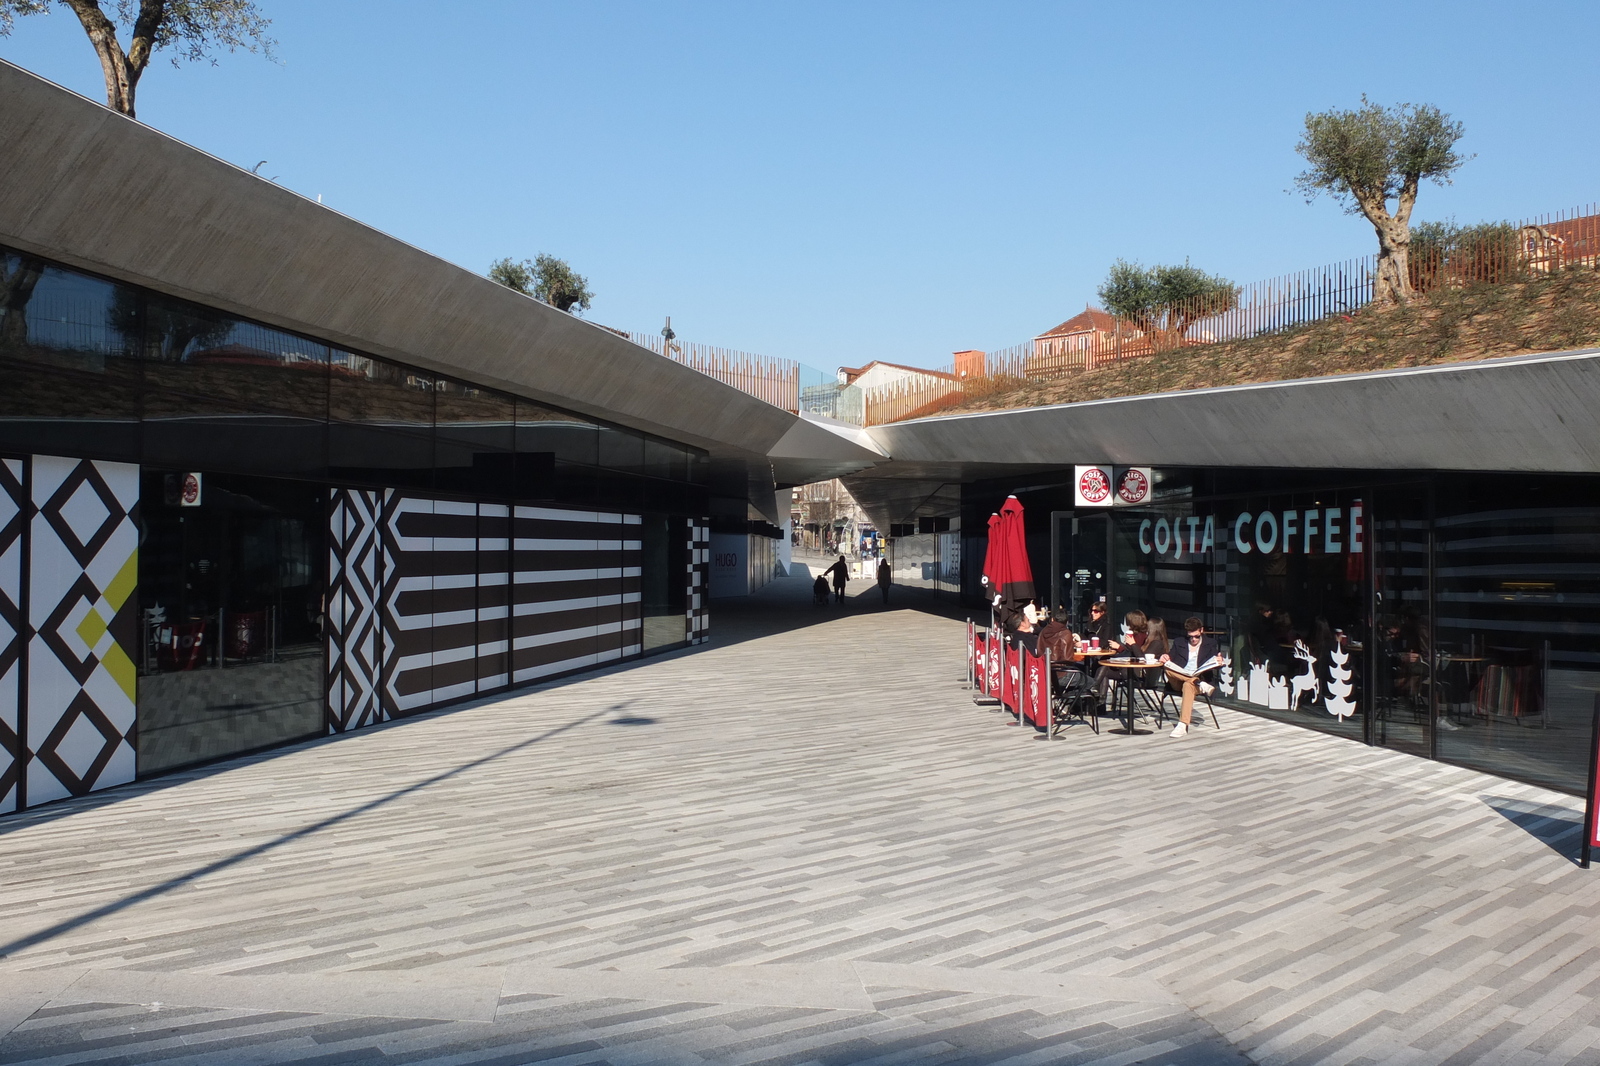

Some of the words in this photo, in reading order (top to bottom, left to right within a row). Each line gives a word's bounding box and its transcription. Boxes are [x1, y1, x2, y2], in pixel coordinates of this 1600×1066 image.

[1084, 471, 1104, 481] COSTA
[1083, 488, 1108, 499] COFFEE
[1139, 515, 1213, 560] COSTA
[1234, 506, 1363, 554] COFFEE
[715, 553, 737, 567] HUGO
